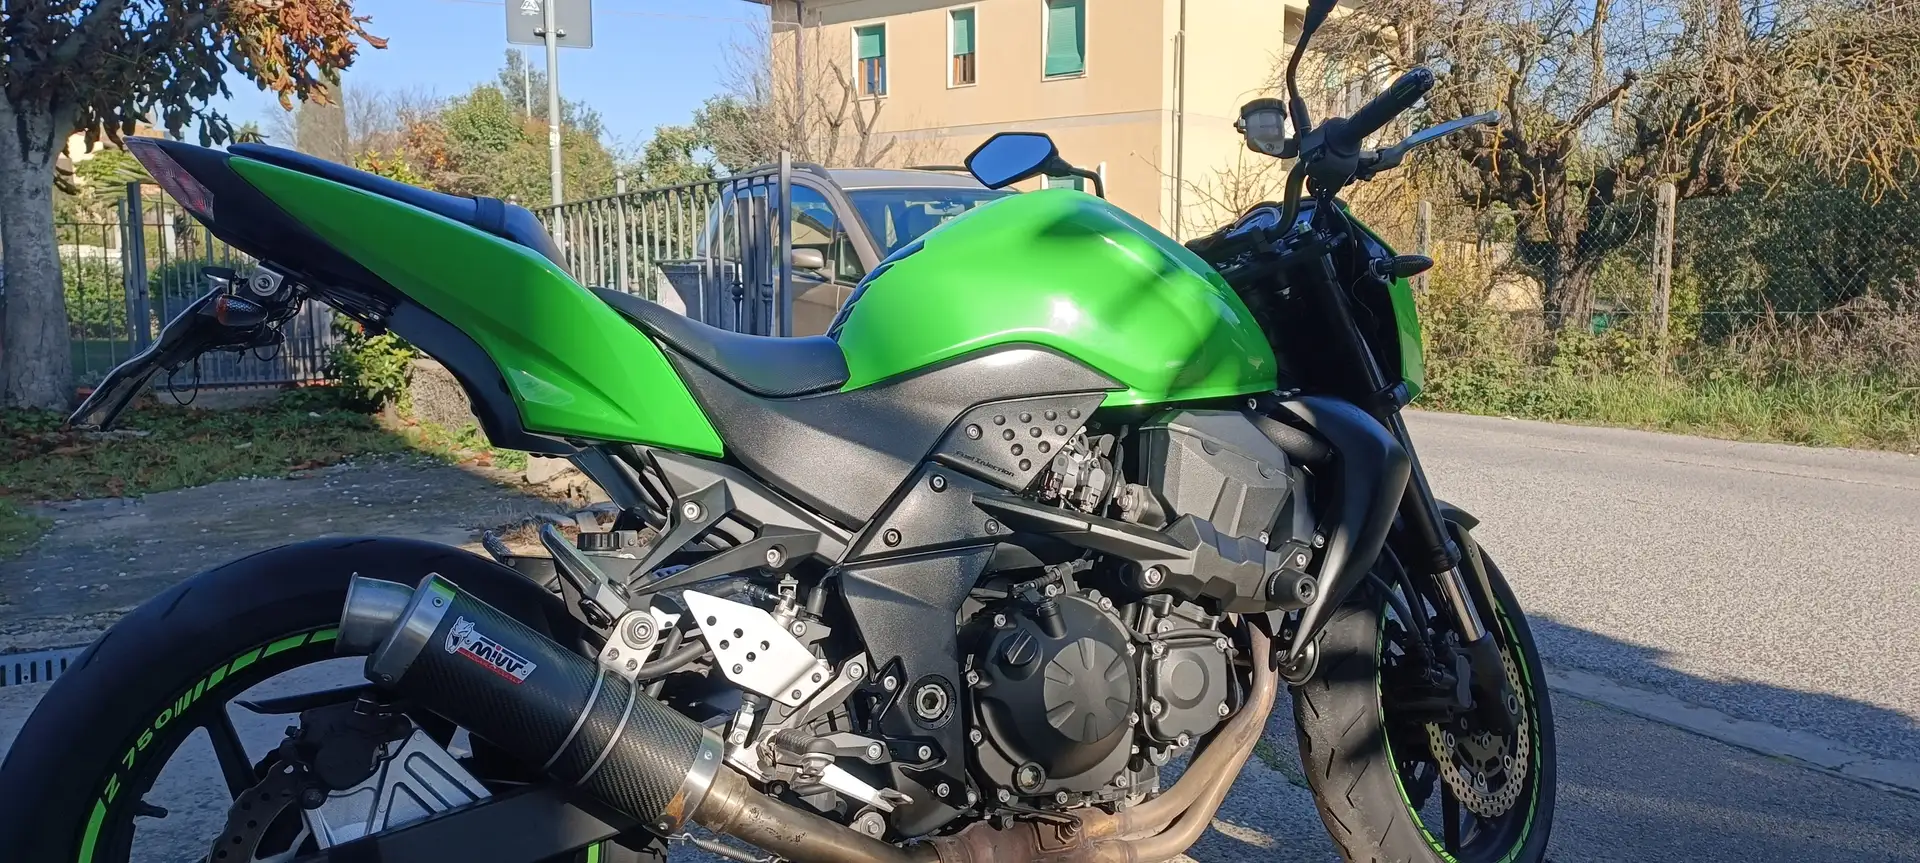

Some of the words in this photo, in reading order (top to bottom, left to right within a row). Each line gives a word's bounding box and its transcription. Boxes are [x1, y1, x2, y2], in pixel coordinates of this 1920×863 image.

[955, 450, 976, 461] Fuel
[975, 457, 1015, 477] Injection
[104, 772, 121, 804] Z
[121, 708, 172, 770] 750
